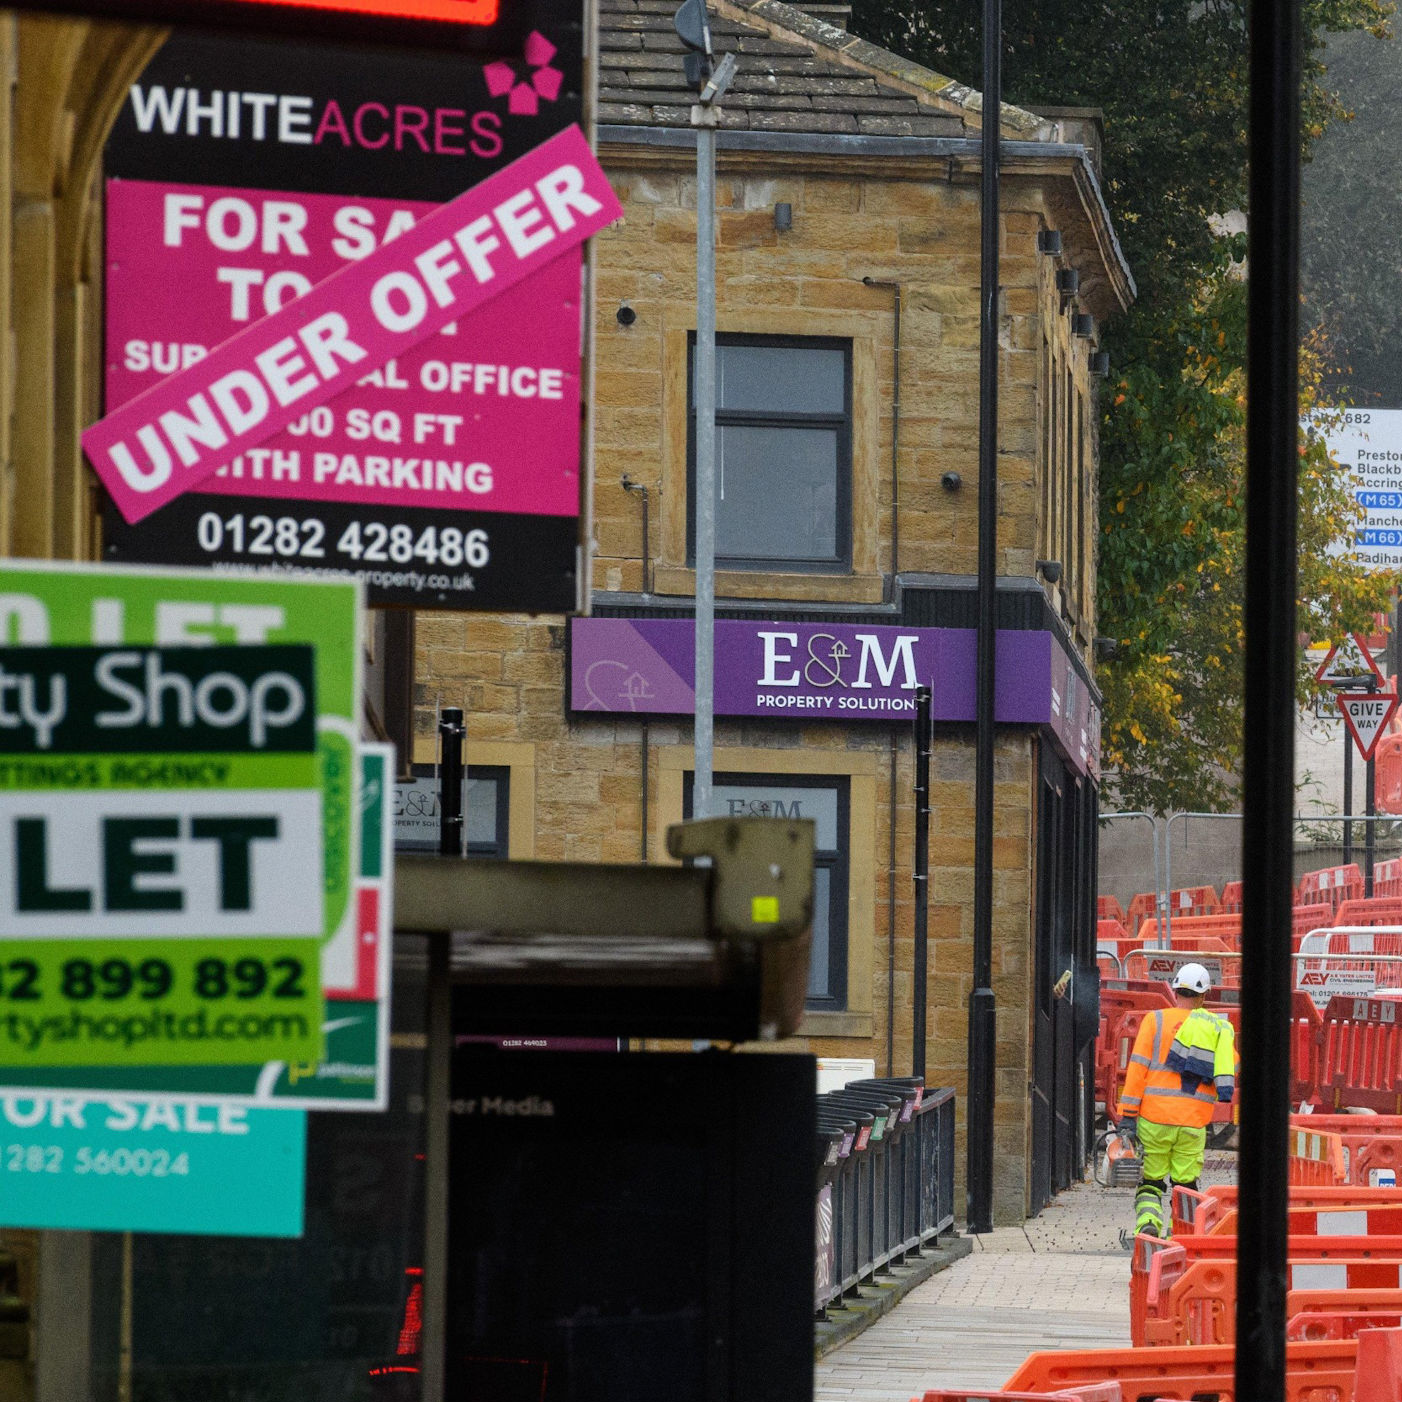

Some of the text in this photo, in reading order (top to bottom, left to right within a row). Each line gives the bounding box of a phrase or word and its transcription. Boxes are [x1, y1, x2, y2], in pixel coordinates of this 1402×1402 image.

[130, 84, 502, 157] WHITEACRES
[163, 193, 309, 256] FOR
[107, 163, 603, 493] UNDER OFFER
[420, 360, 564, 400] OFFICE
[346, 408, 401, 444] SQ
[413, 413, 463, 446] FT
[213, 449, 494, 493] ITH PARKING
[197, 511, 490, 568] 01282 428486
[757, 631, 924, 689] E&M
[95, 650, 305, 749] Shop
[756, 694, 919, 711] PROPERTY SOLUTION
[1350, 703, 1384, 716] GIVE
[1357, 719, 1378, 729] WAY
[15, 816, 279, 911] LET
[61, 957, 174, 1000] 899
[193, 957, 306, 1000] 892
[1300, 972, 1329, 985] AEY
[481, 1096, 555, 1117] Media
[73, 1147, 190, 1177] 560024
